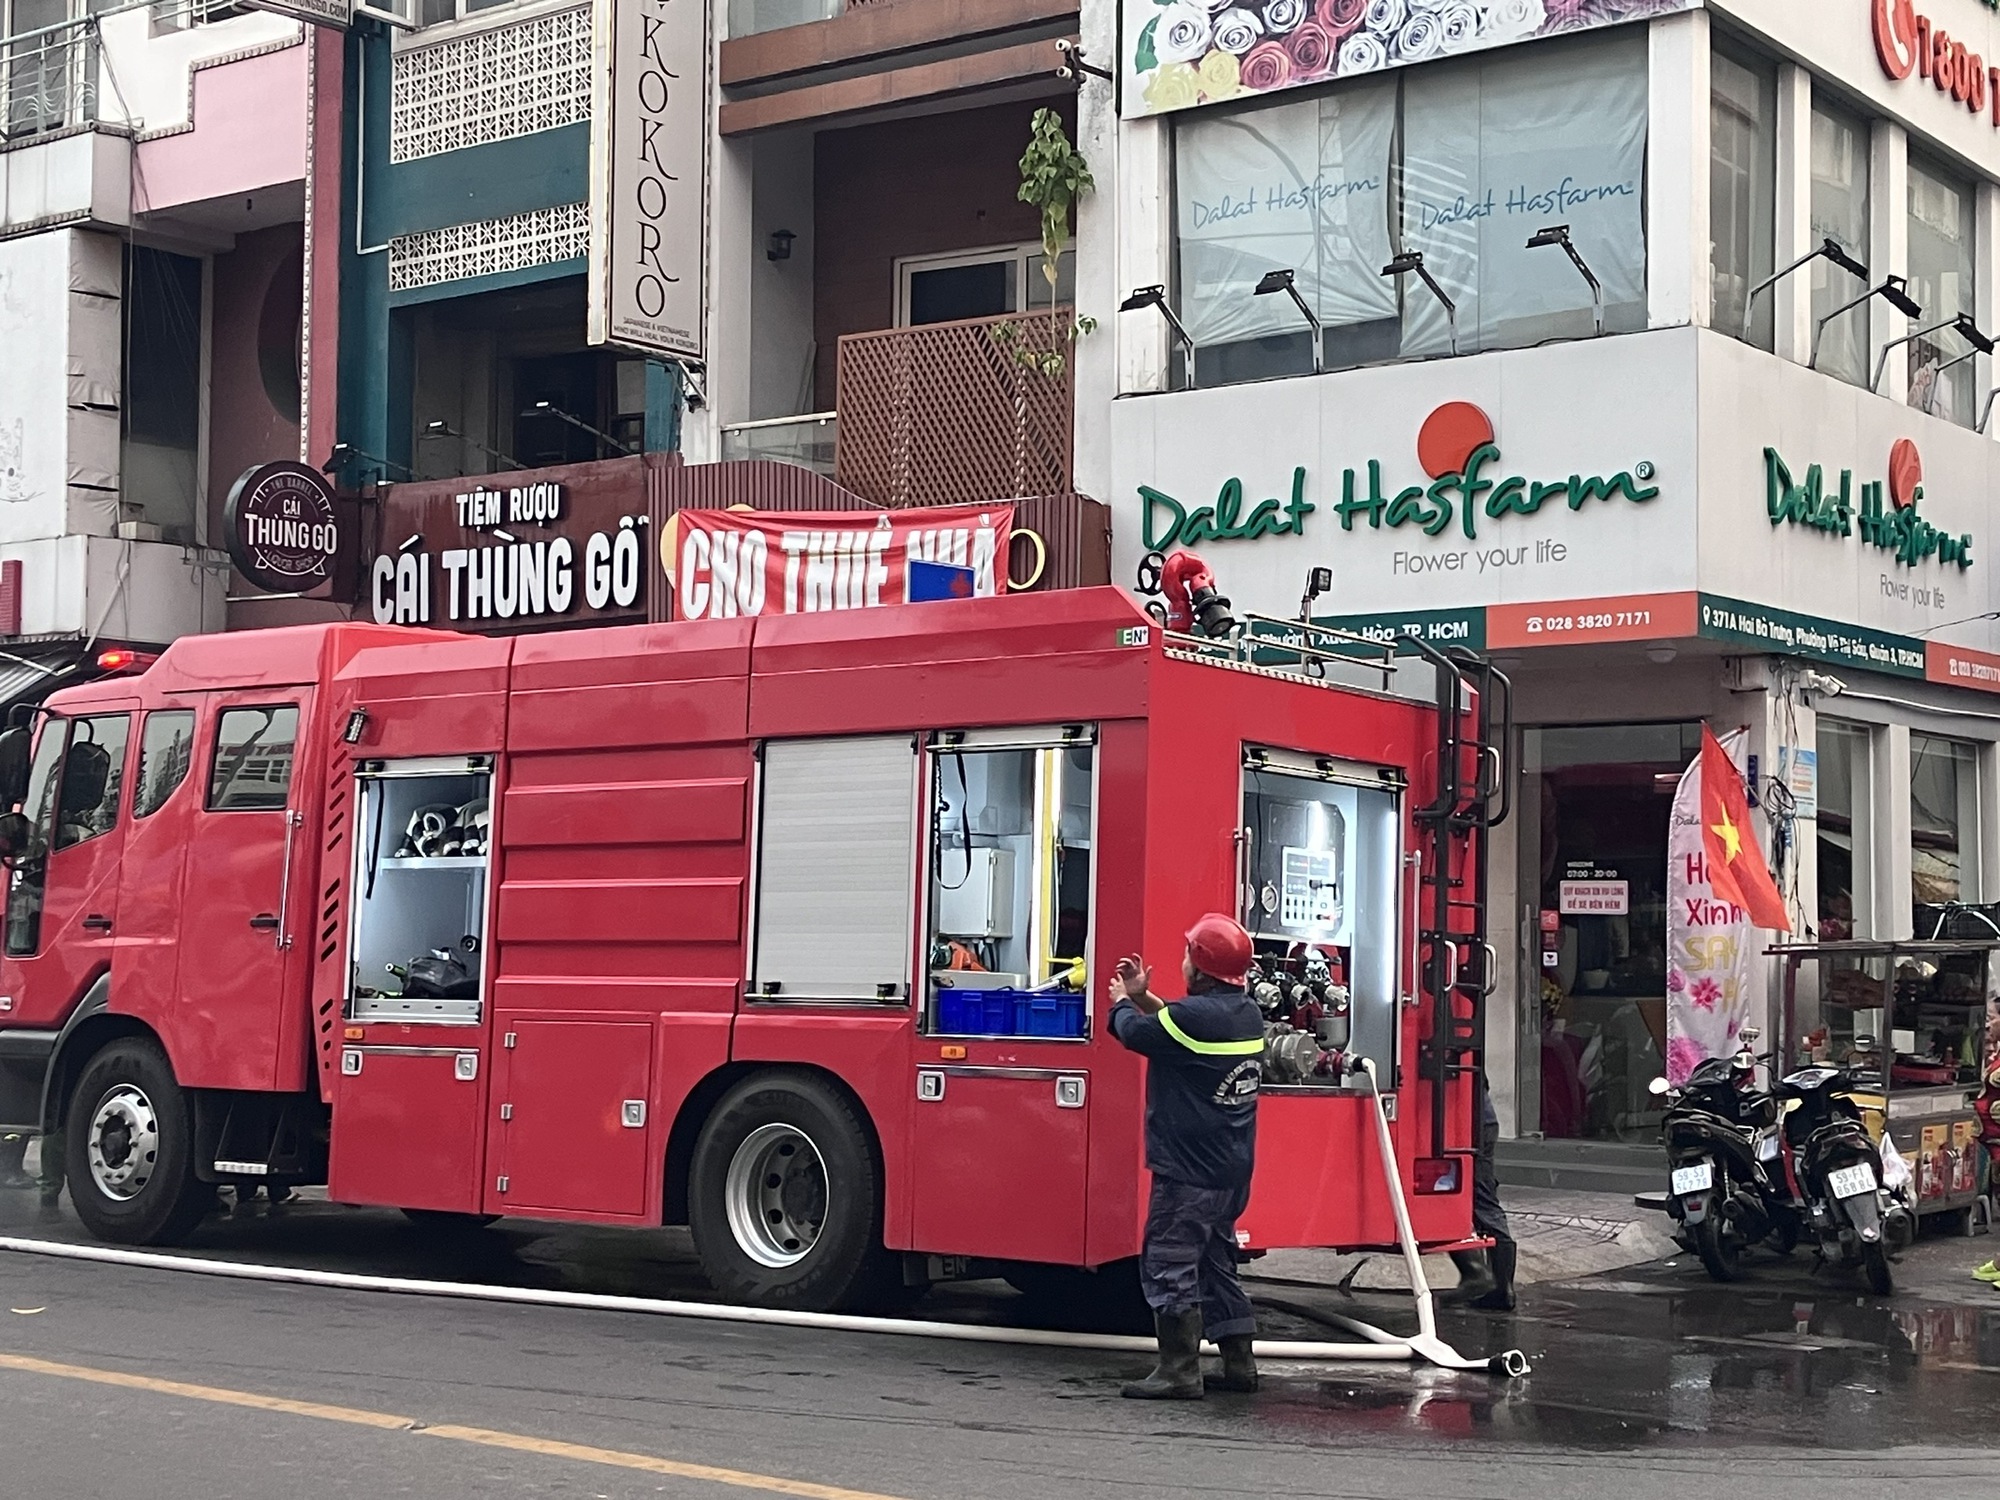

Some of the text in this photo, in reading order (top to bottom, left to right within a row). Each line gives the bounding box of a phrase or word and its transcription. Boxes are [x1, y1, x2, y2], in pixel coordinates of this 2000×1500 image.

[1915, 14, 1985, 113] 1800
[635, 12, 680, 318] KOKORO
[1191, 186, 1258, 229] Dalat
[1420, 188, 1497, 230] Dalat
[283, 496, 301, 515] CÁI
[456, 482, 560, 531] TIỆM RƯỢU
[1137, 466, 1316, 551] Dalat
[1763, 446, 1856, 537] Dalat
[244, 513, 338, 555] THÙNG GỖ
[372, 534, 430, 625] CÁI
[442, 529, 573, 620] THÙNG
[682, 528, 769, 621] CHO
[1393, 538, 1568, 575] Flower your life
[1879, 573, 1945, 610] Flower your life
[1429, 621, 1468, 639] HCM
[1546, 611, 1650, 631] 028 3820 7171
[1712, 609, 1738, 631] 371A
[1738, 614, 1755, 635] Hai
[1755, 616, 1768, 637] Bà
[1675, 814, 1701, 826] Dala
